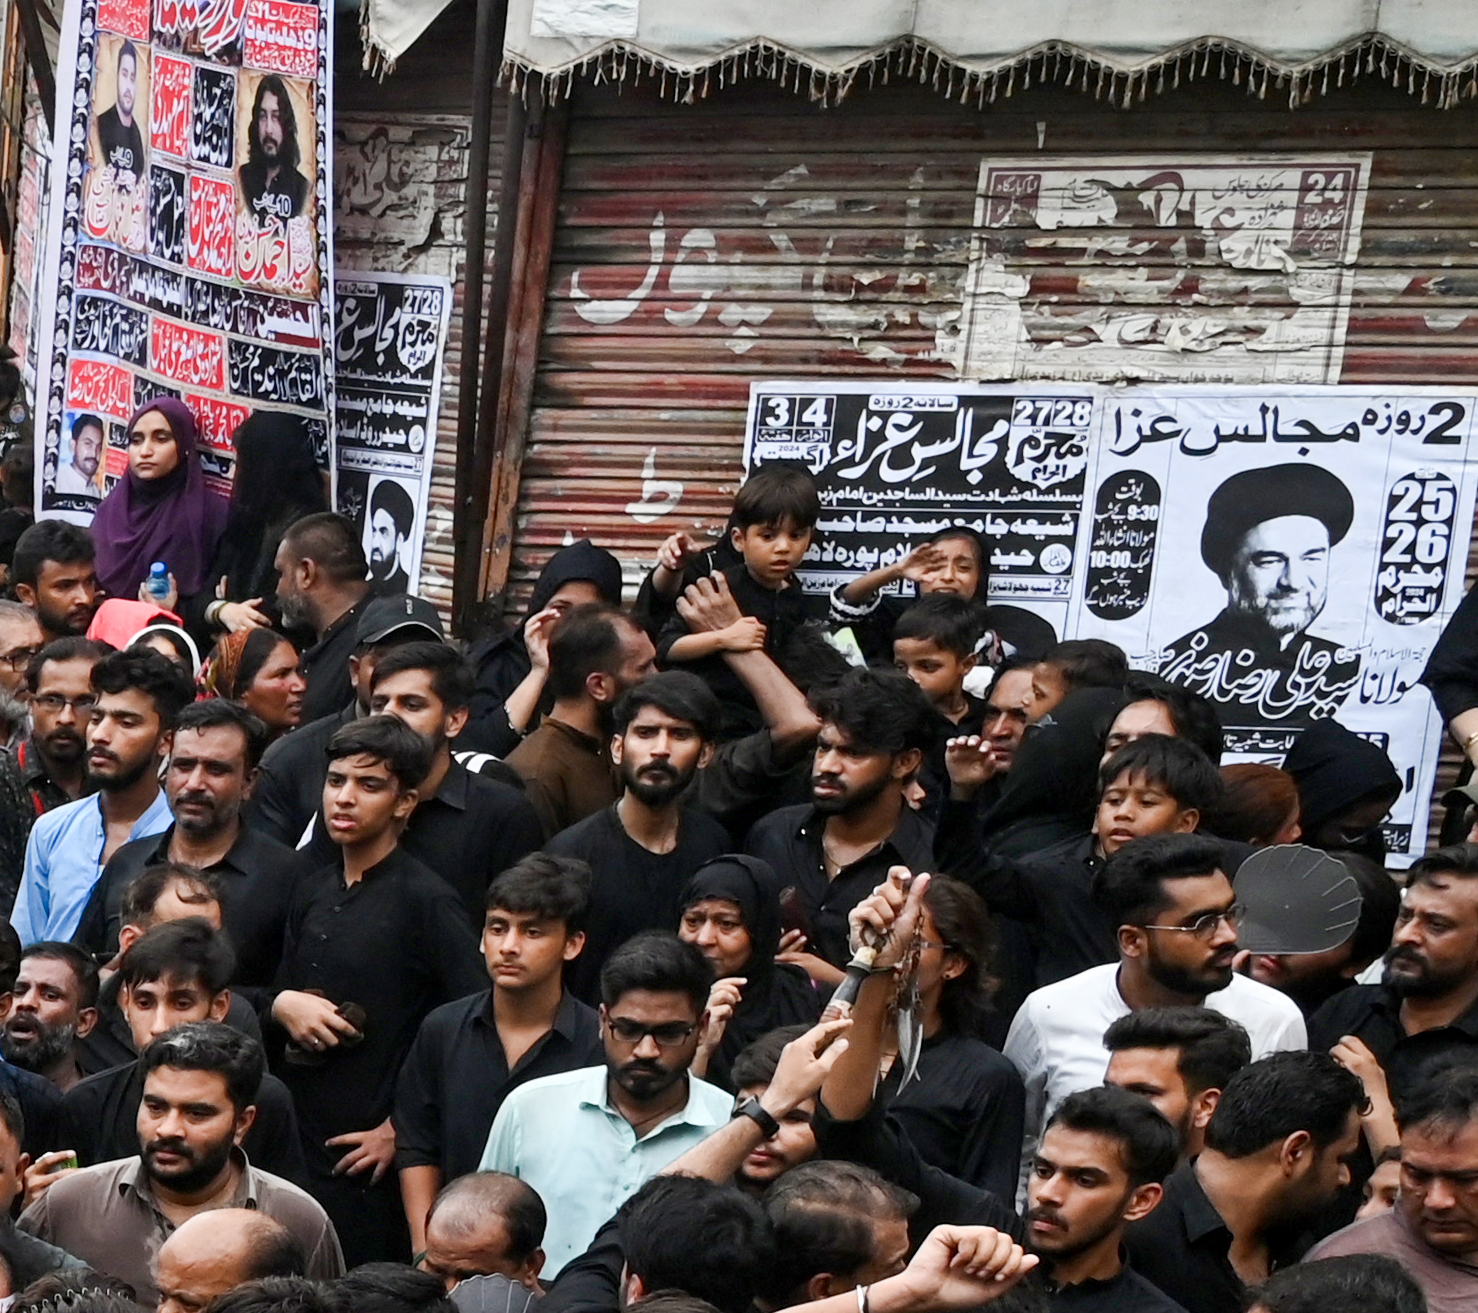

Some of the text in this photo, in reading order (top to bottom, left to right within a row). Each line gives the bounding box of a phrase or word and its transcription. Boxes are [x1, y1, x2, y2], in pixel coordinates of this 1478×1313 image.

[1304, 173, 1344, 203] 24
[404, 289, 441, 315] 27 28
[765, 397, 828, 427] 3 4
[901, 397, 914, 409] 2
[1015, 401, 1092, 426] 27 28
[1361, 402, 1425, 436] روزہ
[1423, 401, 1465, 445] 2
[1127, 504, 1159, 521] 9:30
[1388, 479, 1454, 522] 25
[815, 511, 886, 535] صاحب
[885, 514, 952, 538] مسجد
[1010, 512, 1075, 540] شیعہ
[1382, 522, 1449, 564] 26
[989, 547, 1036, 571] حید
[1089, 550, 1131, 569] 10:00
[1054, 579, 1070, 591] 27
[1377, 564, 1445, 597] محرم
[1381, 592, 1437, 618] الحرام
